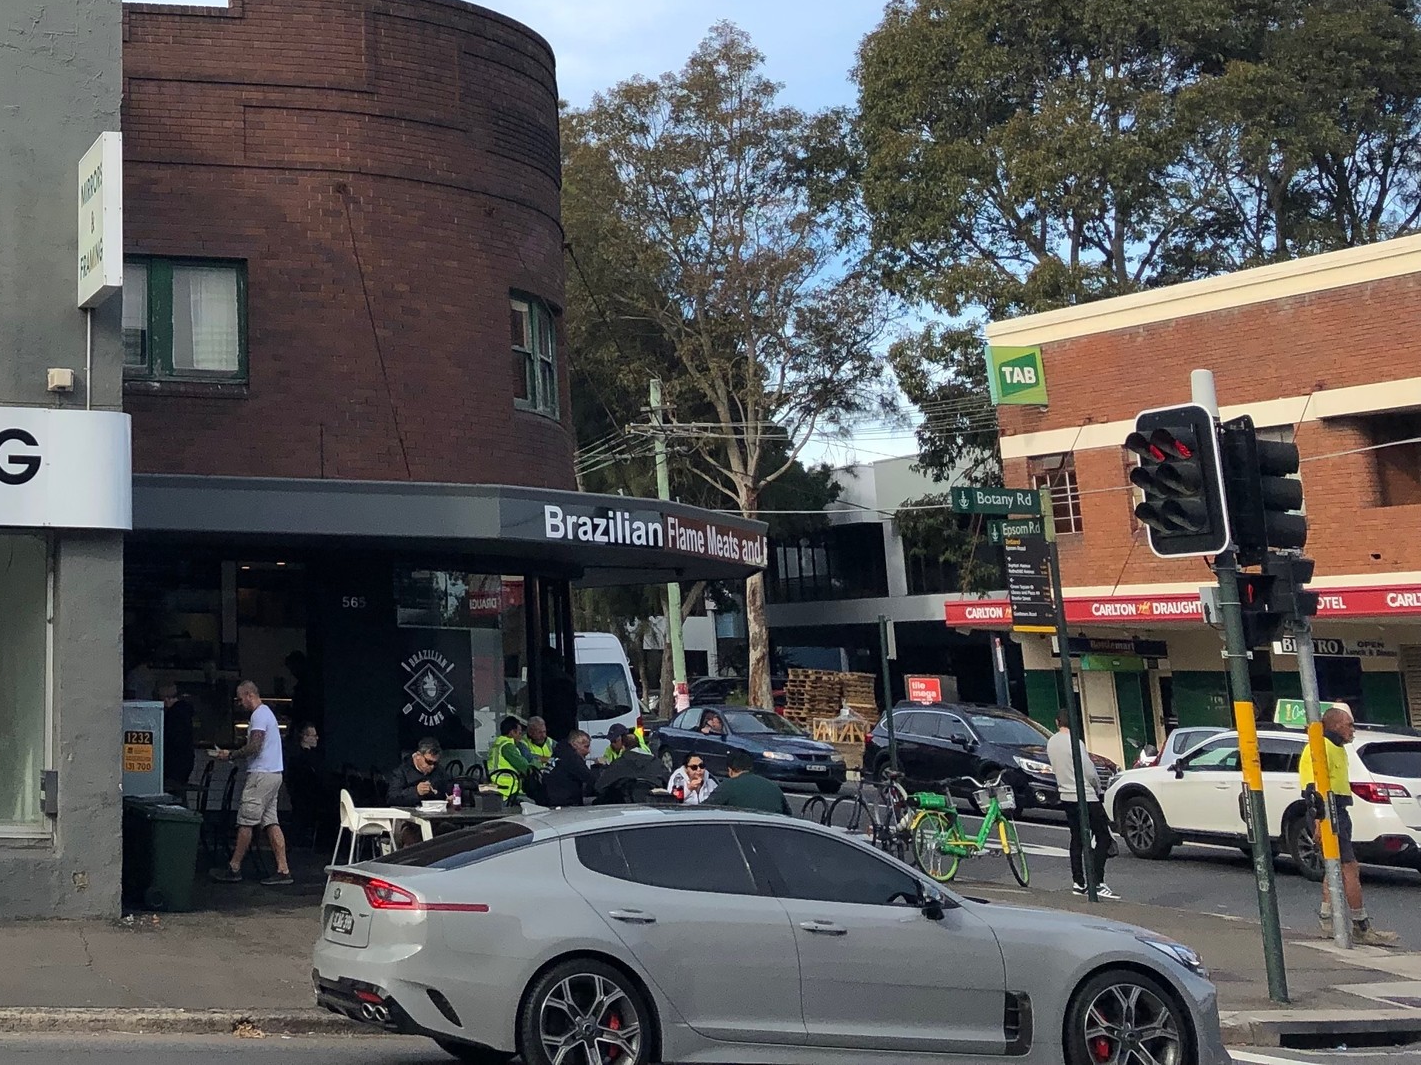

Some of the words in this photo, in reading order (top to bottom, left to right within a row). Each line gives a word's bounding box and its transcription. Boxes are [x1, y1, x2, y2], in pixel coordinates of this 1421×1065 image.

[81, 161, 103, 208] MIRRORS
[80, 237, 103, 281] FRAMING
[1002, 366, 1036, 384] TAB
[976, 491, 1013, 508] Botany
[1016, 492, 1032, 505] Rd
[544, 504, 664, 547] Brazilian
[667, 516, 704, 554] Flame
[706, 525, 739, 560] Meats
[742, 537, 761, 564] and
[1002, 522, 1028, 537] Epsom
[1029, 521, 1040, 534] Rd
[1317, 596, 1347, 610] OTEL
[1387, 592, 1421, 607] CARL
[965, 607, 1003, 619] CARLTON
[1092, 603, 1136, 616] CARLTON
[1152, 601, 1201, 615] DRAUGHT
[1282, 637, 1338, 654] BITRO
[1357, 641, 1385, 649] OPEN
[912, 691, 937, 700] mega
[127, 733, 150, 744] 1232
